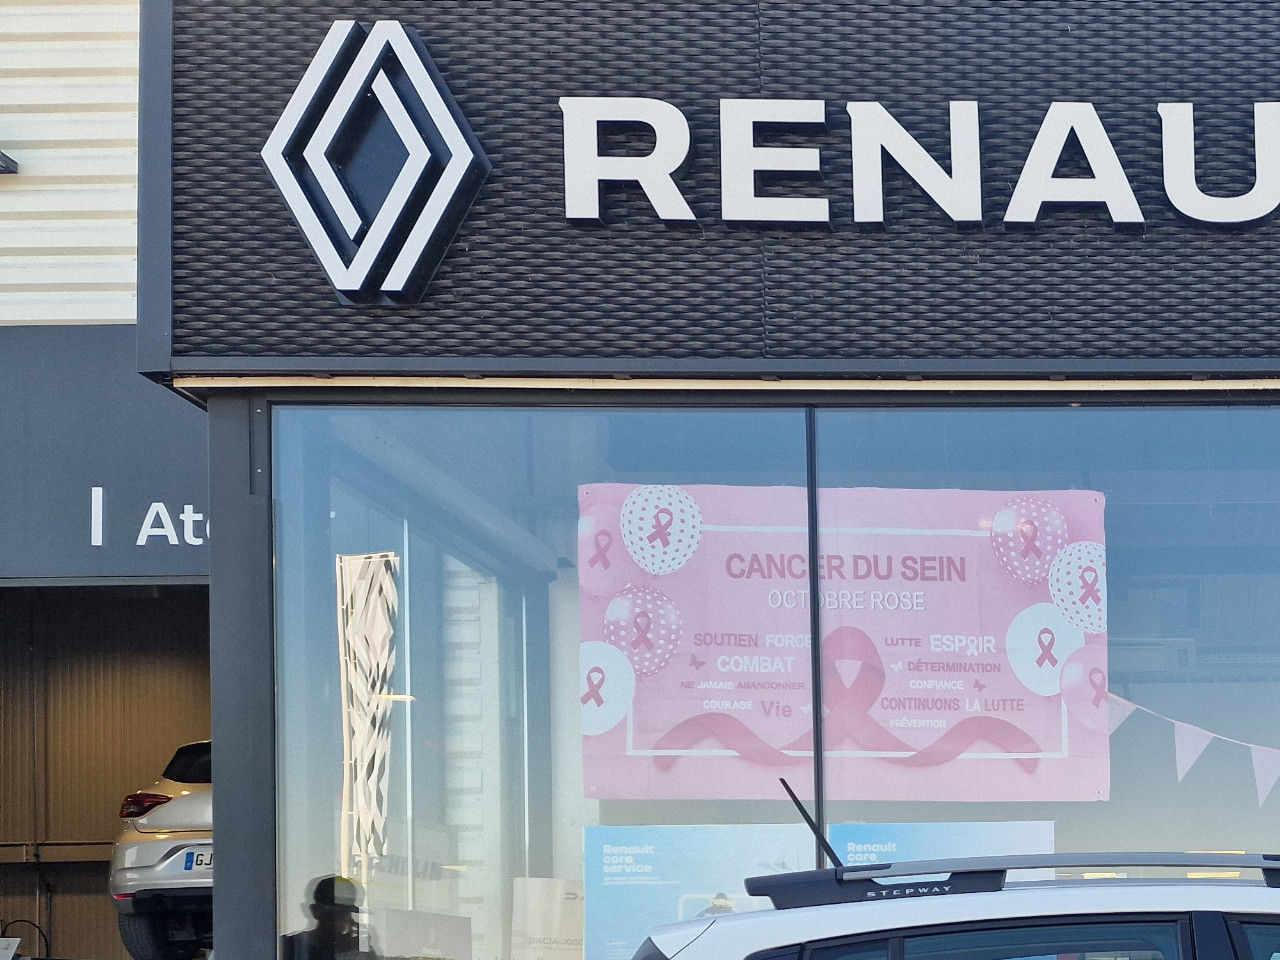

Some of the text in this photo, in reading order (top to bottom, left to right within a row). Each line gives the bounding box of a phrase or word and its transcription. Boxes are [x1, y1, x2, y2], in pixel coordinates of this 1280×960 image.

[136, 502, 210, 546] At
[853, 554, 893, 581] DU
[900, 556, 966, 582] SEIN
[870, 590, 926, 611] ROSE
[693, 632, 811, 648] SOUTIEN FORCE
[885, 637, 922, 647] LUTTE
[717, 655, 795, 672] COMBAT
[908, 658, 1001, 673] DÉTERMINATION
[680, 681, 805, 690] NE JAMAIS ABANDONNER
[909, 680, 964, 690] CONFIANCE
[703, 700, 792, 718] COURAGE Vie
[881, 697, 1024, 712] CONTINUONS LA LUTTE
[889, 717, 947, 728] PRÉVENTION
[603, 844, 655, 854] Renault
[847, 842, 897, 852] Renault
[603, 855, 634, 864] care
[847, 852, 877, 862] care
[603, 863, 652, 873] service
[867, 885, 951, 898] STEPWAY
